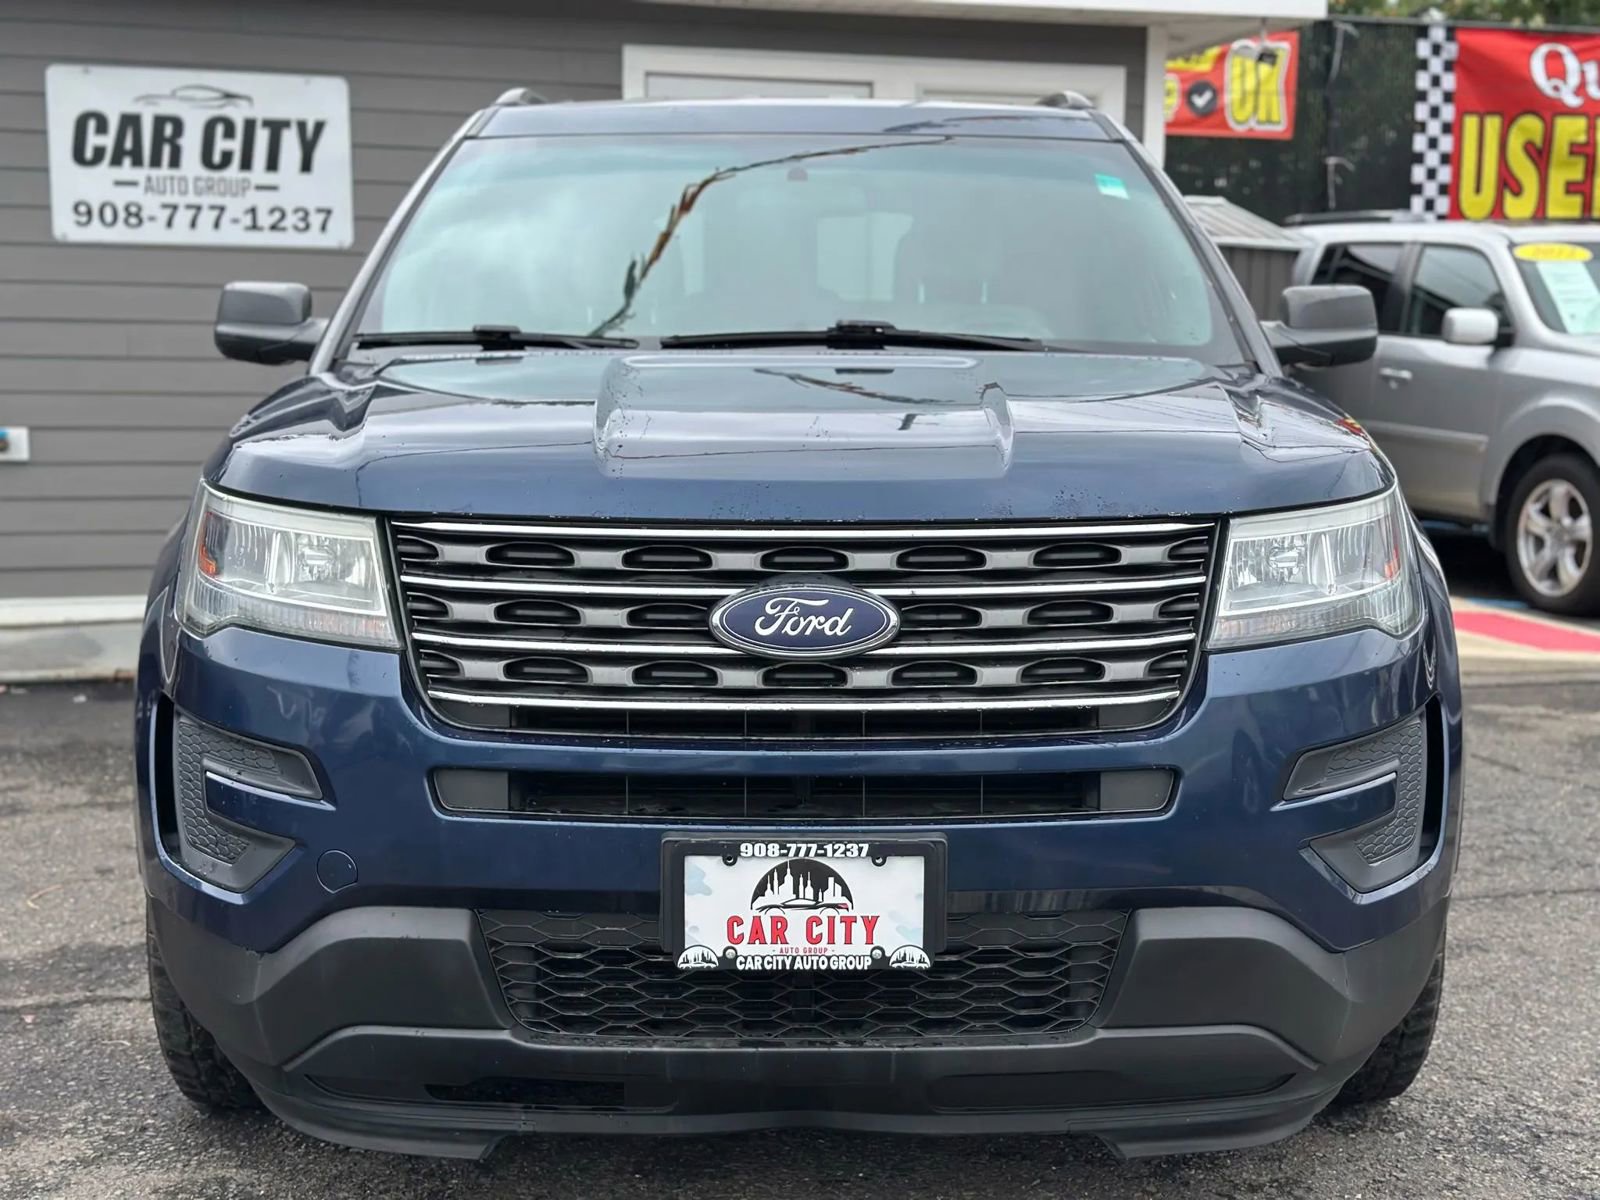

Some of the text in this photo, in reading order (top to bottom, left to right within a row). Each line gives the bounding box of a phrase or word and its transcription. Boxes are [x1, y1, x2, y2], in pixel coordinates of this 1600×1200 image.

[71, 110, 327, 174] CAR CITY
[1459, 112, 1600, 221] USE
[144, 175, 252, 198] AUTO GROUP
[72, 200, 334, 235] 908-777-1237
[754, 597, 854, 636] Ford
[740, 842, 869, 858] 908-777-1237
[726, 915, 880, 945] CAR CITY
[736, 955, 872, 970] CAR CITY AUTO GROUP
[779, 946, 828, 954] AUTO GROUP
